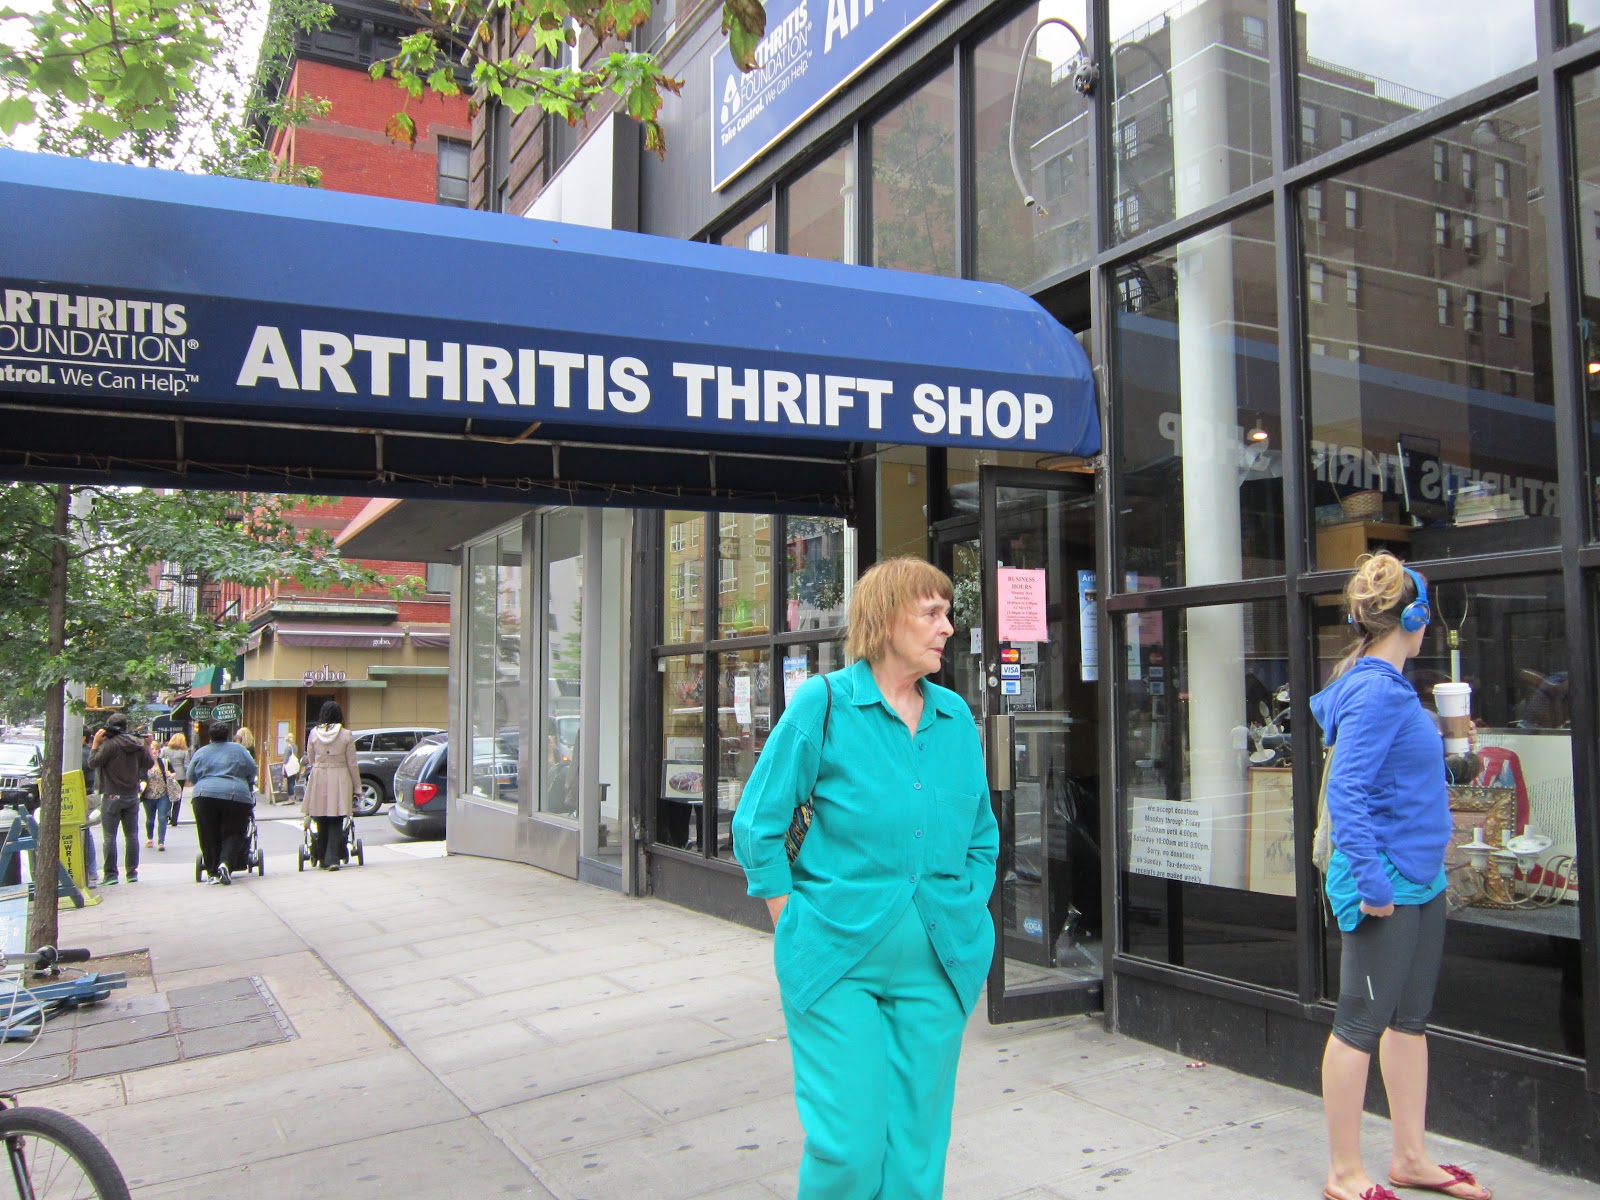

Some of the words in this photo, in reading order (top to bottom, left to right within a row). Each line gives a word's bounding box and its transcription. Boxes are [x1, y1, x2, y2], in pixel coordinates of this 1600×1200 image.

[721, 126, 737, 146] Take
[737, 97, 765, 132] Control.
[764, 87, 776, 106] We
[776, 75, 790, 94] Can
[0, 289, 187, 336] RTHRITIS
[60, 367, 93, 387] We
[98, 371, 136, 389] Can
[236, 325, 651, 413] ARTHRITIS
[672, 362, 894, 429] THRIFT
[912, 383, 1054, 440] SHOP
[302, 664, 346, 687] gobo
[1174, 807, 1199, 815] donations
[1144, 815, 1164, 824] Monday
[1165, 817, 1184, 826] through
[1185, 819, 1201, 828] Friday
[1133, 835, 1154, 844] Saturday
[1170, 850, 1195, 859] donations
[1166, 860, 1202, 871] Tax-deductible
[1135, 867, 1155, 876] receipts
[1166, 872, 1183, 880] mailed
